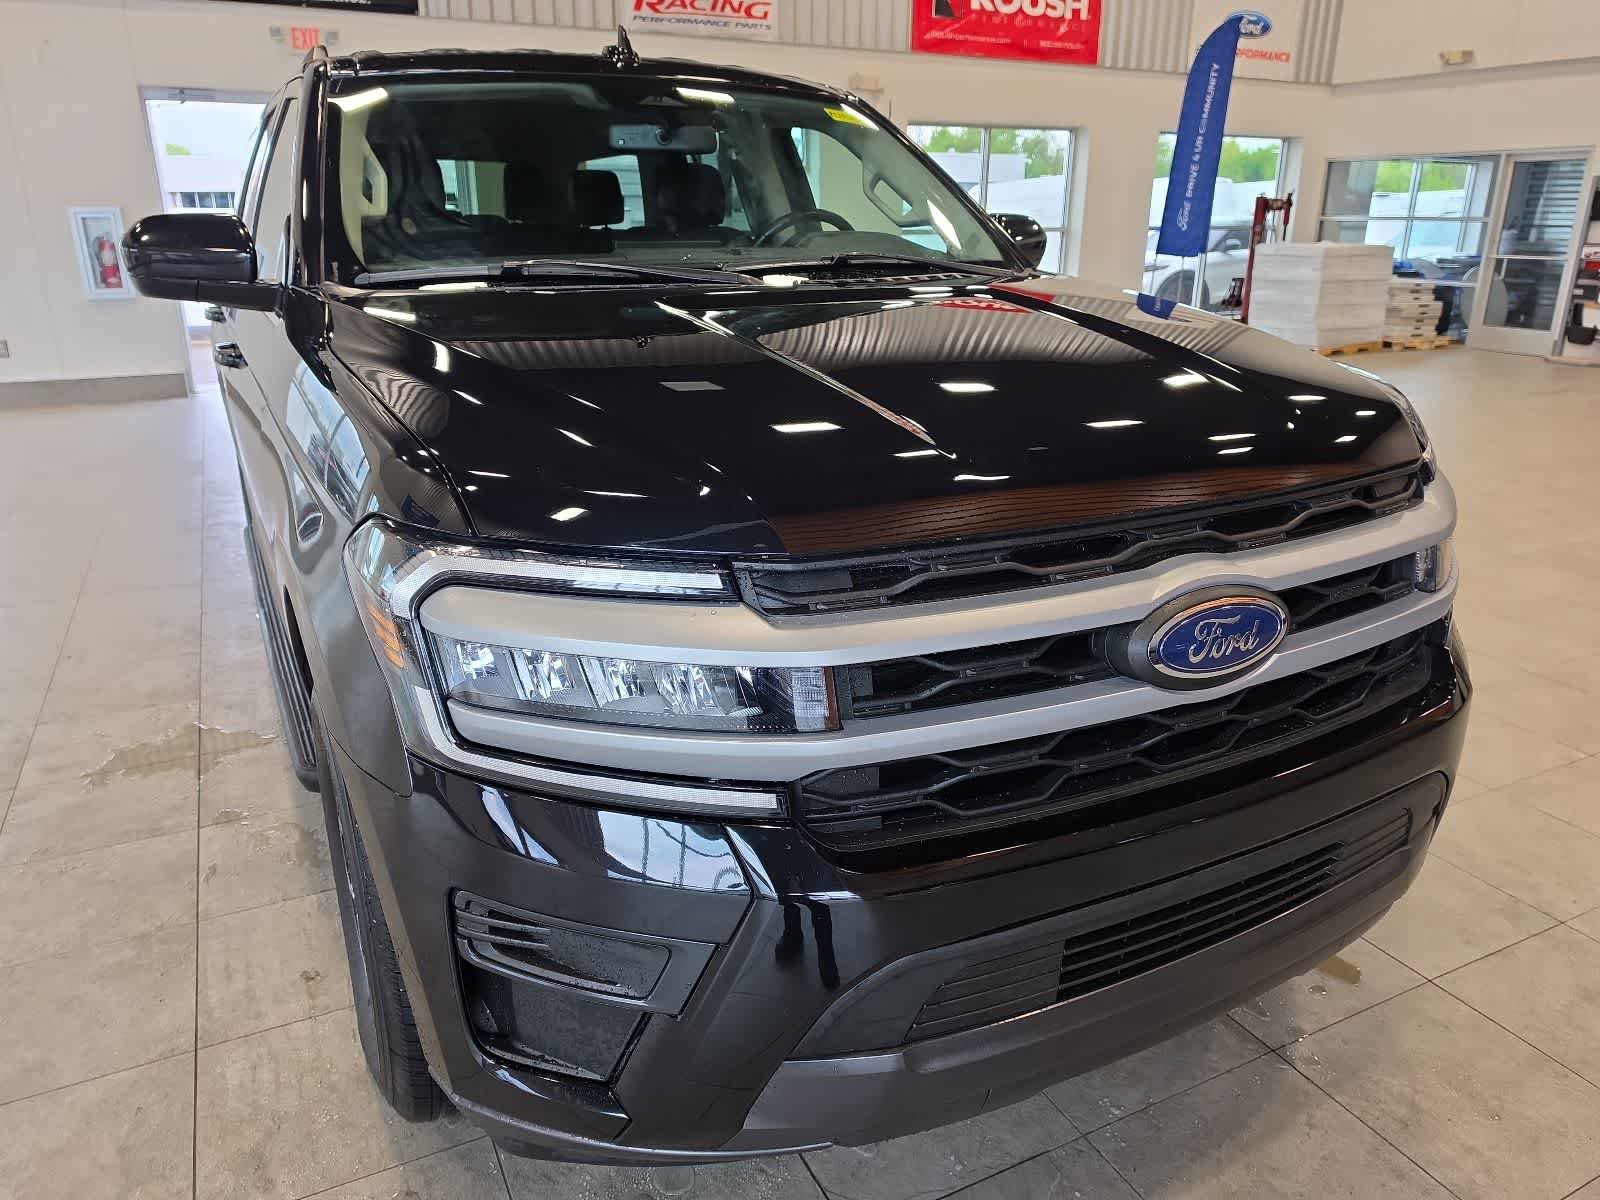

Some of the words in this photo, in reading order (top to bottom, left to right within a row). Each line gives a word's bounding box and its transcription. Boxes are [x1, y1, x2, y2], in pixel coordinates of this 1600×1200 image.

[633, 0, 772, 20] RACING
[633, 15, 731, 28] PERFORMANCE
[735, 22, 772, 31] PARTS
[291, 27, 320, 49] EXIT
[1235, 48, 1290, 63] RFORMANCE
[1176, 200, 1191, 231] Ford
[1186, 164, 1200, 197] DRIVE
[1199, 63, 1221, 134] COMMUNITY
[1188, 615, 1260, 663] Ford
